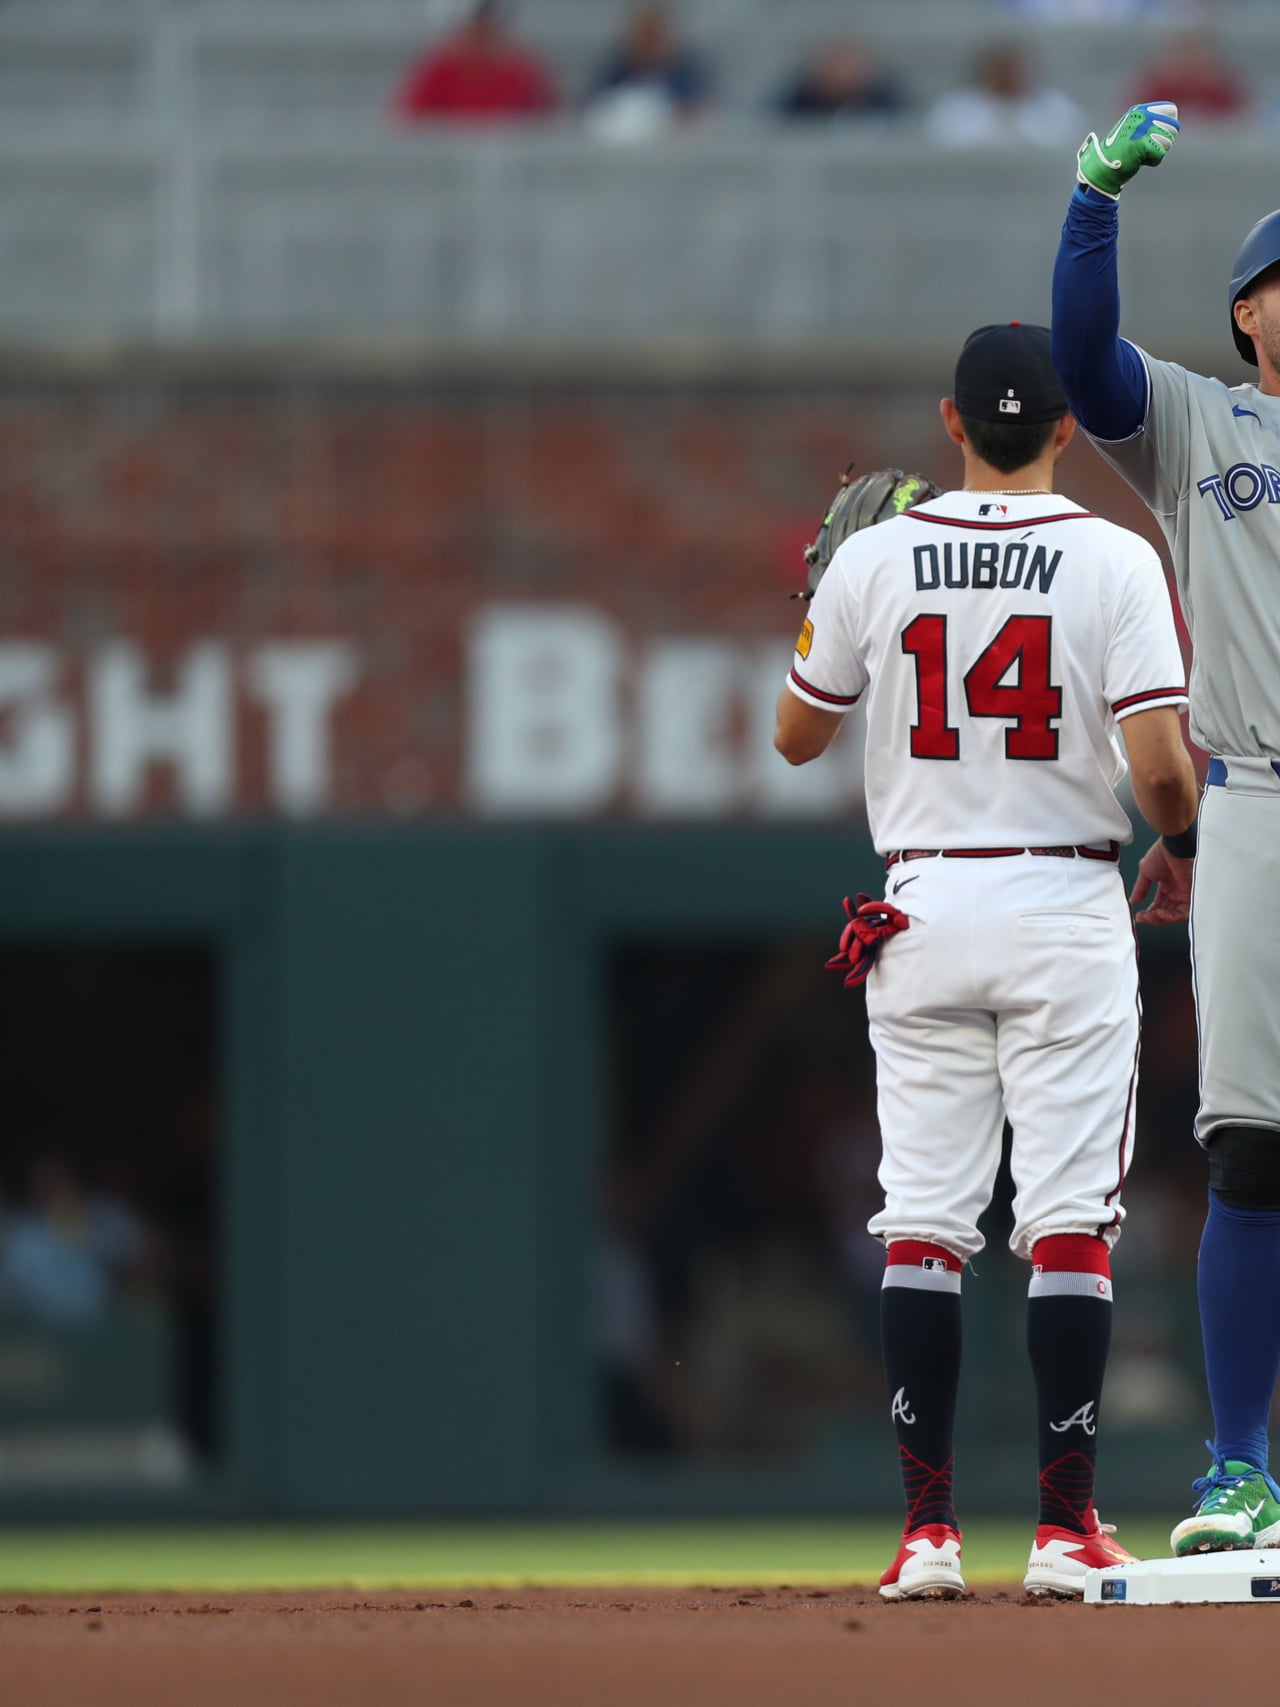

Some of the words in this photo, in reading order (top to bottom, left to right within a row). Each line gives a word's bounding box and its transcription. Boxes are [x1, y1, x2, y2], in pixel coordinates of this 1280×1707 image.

[913, 531, 1063, 595] DUBÓN
[901, 613, 1063, 761] 14
[1050, 1400, 1096, 1435] A
